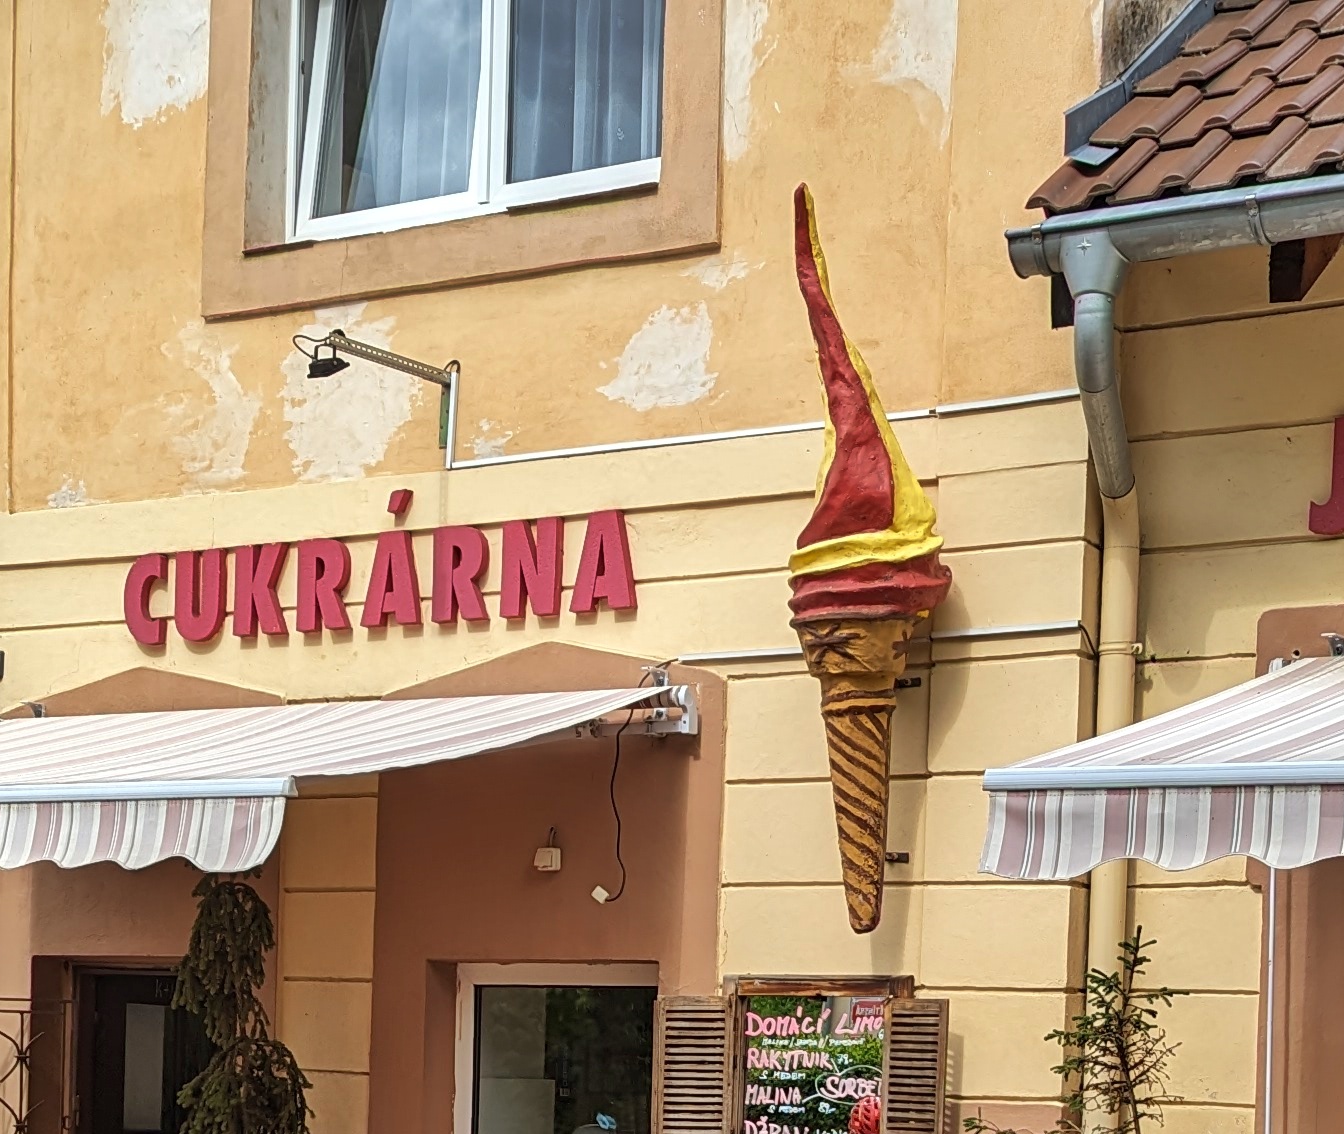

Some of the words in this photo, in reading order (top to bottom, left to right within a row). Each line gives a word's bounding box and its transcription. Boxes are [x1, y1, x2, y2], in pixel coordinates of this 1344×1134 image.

[124, 488, 638, 646] CUKRÁRNA
[745, 1006, 832, 1037] DOMÁCÍ
[744, 1084, 802, 1105] MALINA
